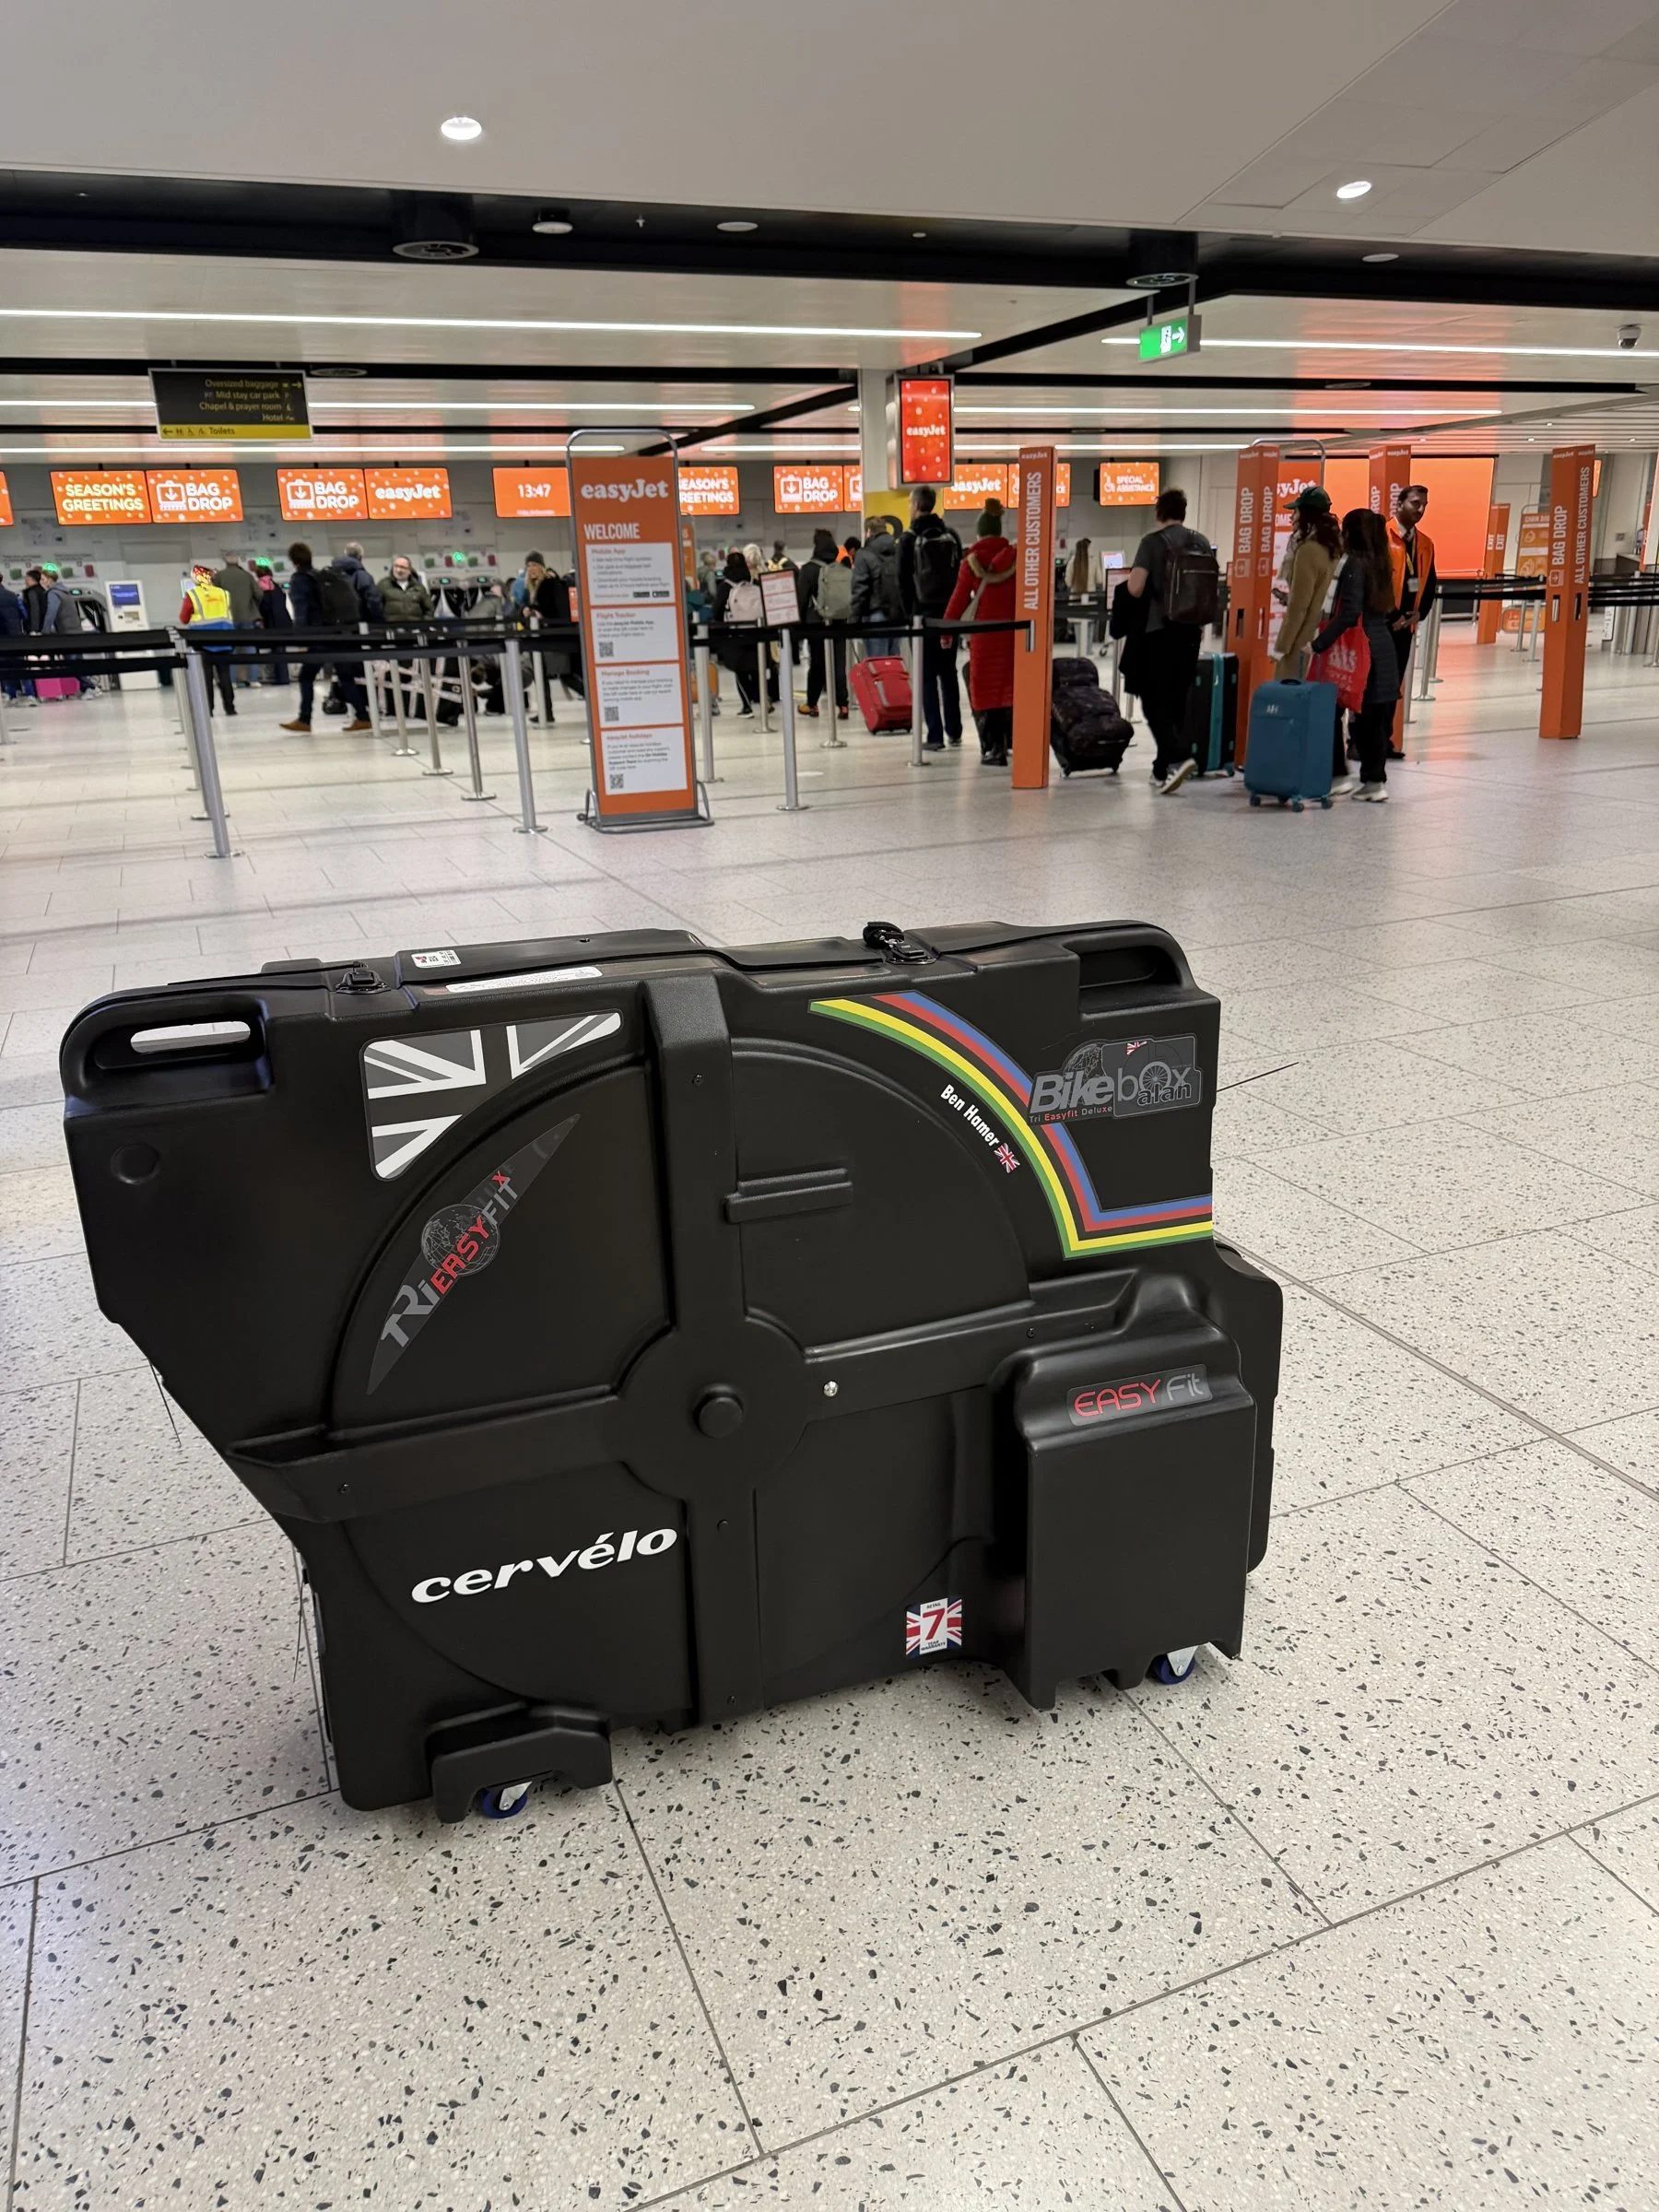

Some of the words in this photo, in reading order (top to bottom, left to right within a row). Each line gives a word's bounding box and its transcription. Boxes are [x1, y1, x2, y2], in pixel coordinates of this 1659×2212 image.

[205, 379, 243, 388] Oversized
[245, 380, 278, 389] baggage
[232, 392, 248, 400] stay
[263, 392, 280, 400] park
[199, 402, 227, 412] Chapel
[235, 403, 260, 412] prayer
[209, 427, 235, 435] Toilets
[906, 424, 947, 438] easyJet
[314, 481, 347, 495] BAG
[678, 477, 729, 490] EASON'S
[803, 477, 830, 489] BAG
[1116, 475, 1144, 484] SPECIAL
[65, 483, 135, 498] SEASON'S
[185, 482, 220, 497] BAG
[375, 484, 441, 502] easyJet
[517, 484, 552, 499] 13:47
[581, 478, 668, 501] easyJet
[678, 490, 735, 504] REETINGS
[803, 489, 838, 502] DROP
[1116, 484, 1155, 493] ASSISTANCE
[62, 499, 144, 512] GREETINGS
[187, 497, 232, 511] DROP
[315, 495, 359, 509] DROP
[1240, 487, 1253, 524] DROP
[1263, 486, 1274, 523] DROP
[1577, 466, 1590, 529] CUSTOMERS
[1026, 471, 1042, 546] CUSTOMERS
[1553, 506, 1567, 538] DROP
[583, 524, 641, 540] WELCOME
[1239, 527, 1253, 554] BAG
[1261, 526, 1271, 553] BAG
[1552, 539, 1566, 565] BAG
[1575, 529, 1587, 564] OTHER
[1024, 547, 1040, 587] OTHER
[1574, 564, 1584, 584] ALL
[1024, 588, 1039, 610] ALL
[1137, 1083, 1191, 1106] alan
[940, 1084, 966, 1112] Ben
[963, 1104, 1000, 1147] Hamer
[1029, 1115, 1041, 1124] Tri
[1043, 1111, 1077, 1123] Easyfit
[1081, 1106, 1112, 1116] Deluxe
[411, 1528, 677, 1604] cervélo
[923, 1607, 945, 1641] 7
